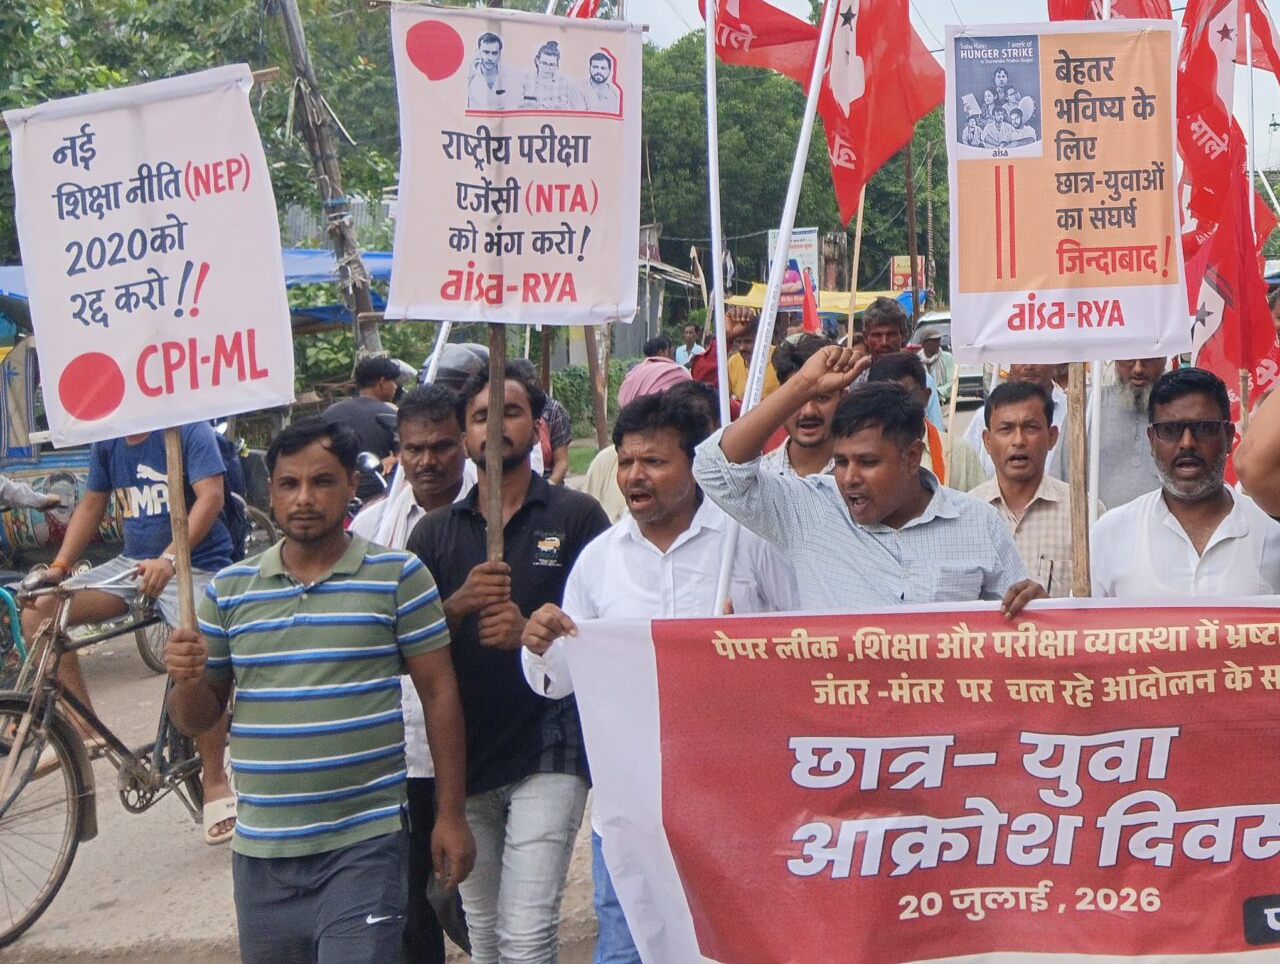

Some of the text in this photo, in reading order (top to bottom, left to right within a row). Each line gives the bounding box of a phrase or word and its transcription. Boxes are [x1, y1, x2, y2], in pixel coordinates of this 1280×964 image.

[960, 48, 1034, 59] HUNGER STRIKE
[1053, 49, 1116, 85] बेहतर
[1054, 86, 1156, 124] भविष्य के
[52, 123, 97, 171] नई
[441, 123, 592, 171] राष्ट्रीय परीक्षा
[1054, 129, 1098, 161] लिए
[51, 153, 251, 221] शिक्षा नीति (NEP)
[455, 176, 599, 216] एजेंसी (NTA)
[1055, 197, 1137, 231] का संघर्ष
[448, 219, 479, 254] को
[483, 224, 525, 257] भंग
[136, 328, 269, 397] CPI-ML
[711, 630, 769, 660] पेपर
[771, 627, 840, 659] लीक
[935, 621, 989, 659] और
[990, 621, 1078, 660] परीक्षा
[1081, 625, 1191, 655] व्यवस्था
[1193, 618, 1221, 650] में
[811, 672, 870, 705] जंतर
[956, 679, 993, 703] पर
[1004, 679, 1055, 704] चल
[1059, 672, 1095, 708] रहे
[1101, 666, 1217, 702] आंदोलन
[1221, 660, 1254, 691] के
[1019, 726, 1181, 808] युवा
[785, 796, 1084, 879] आक्रोश
[898, 891, 943, 920] 20
[1075, 886, 1161, 912] 2026
